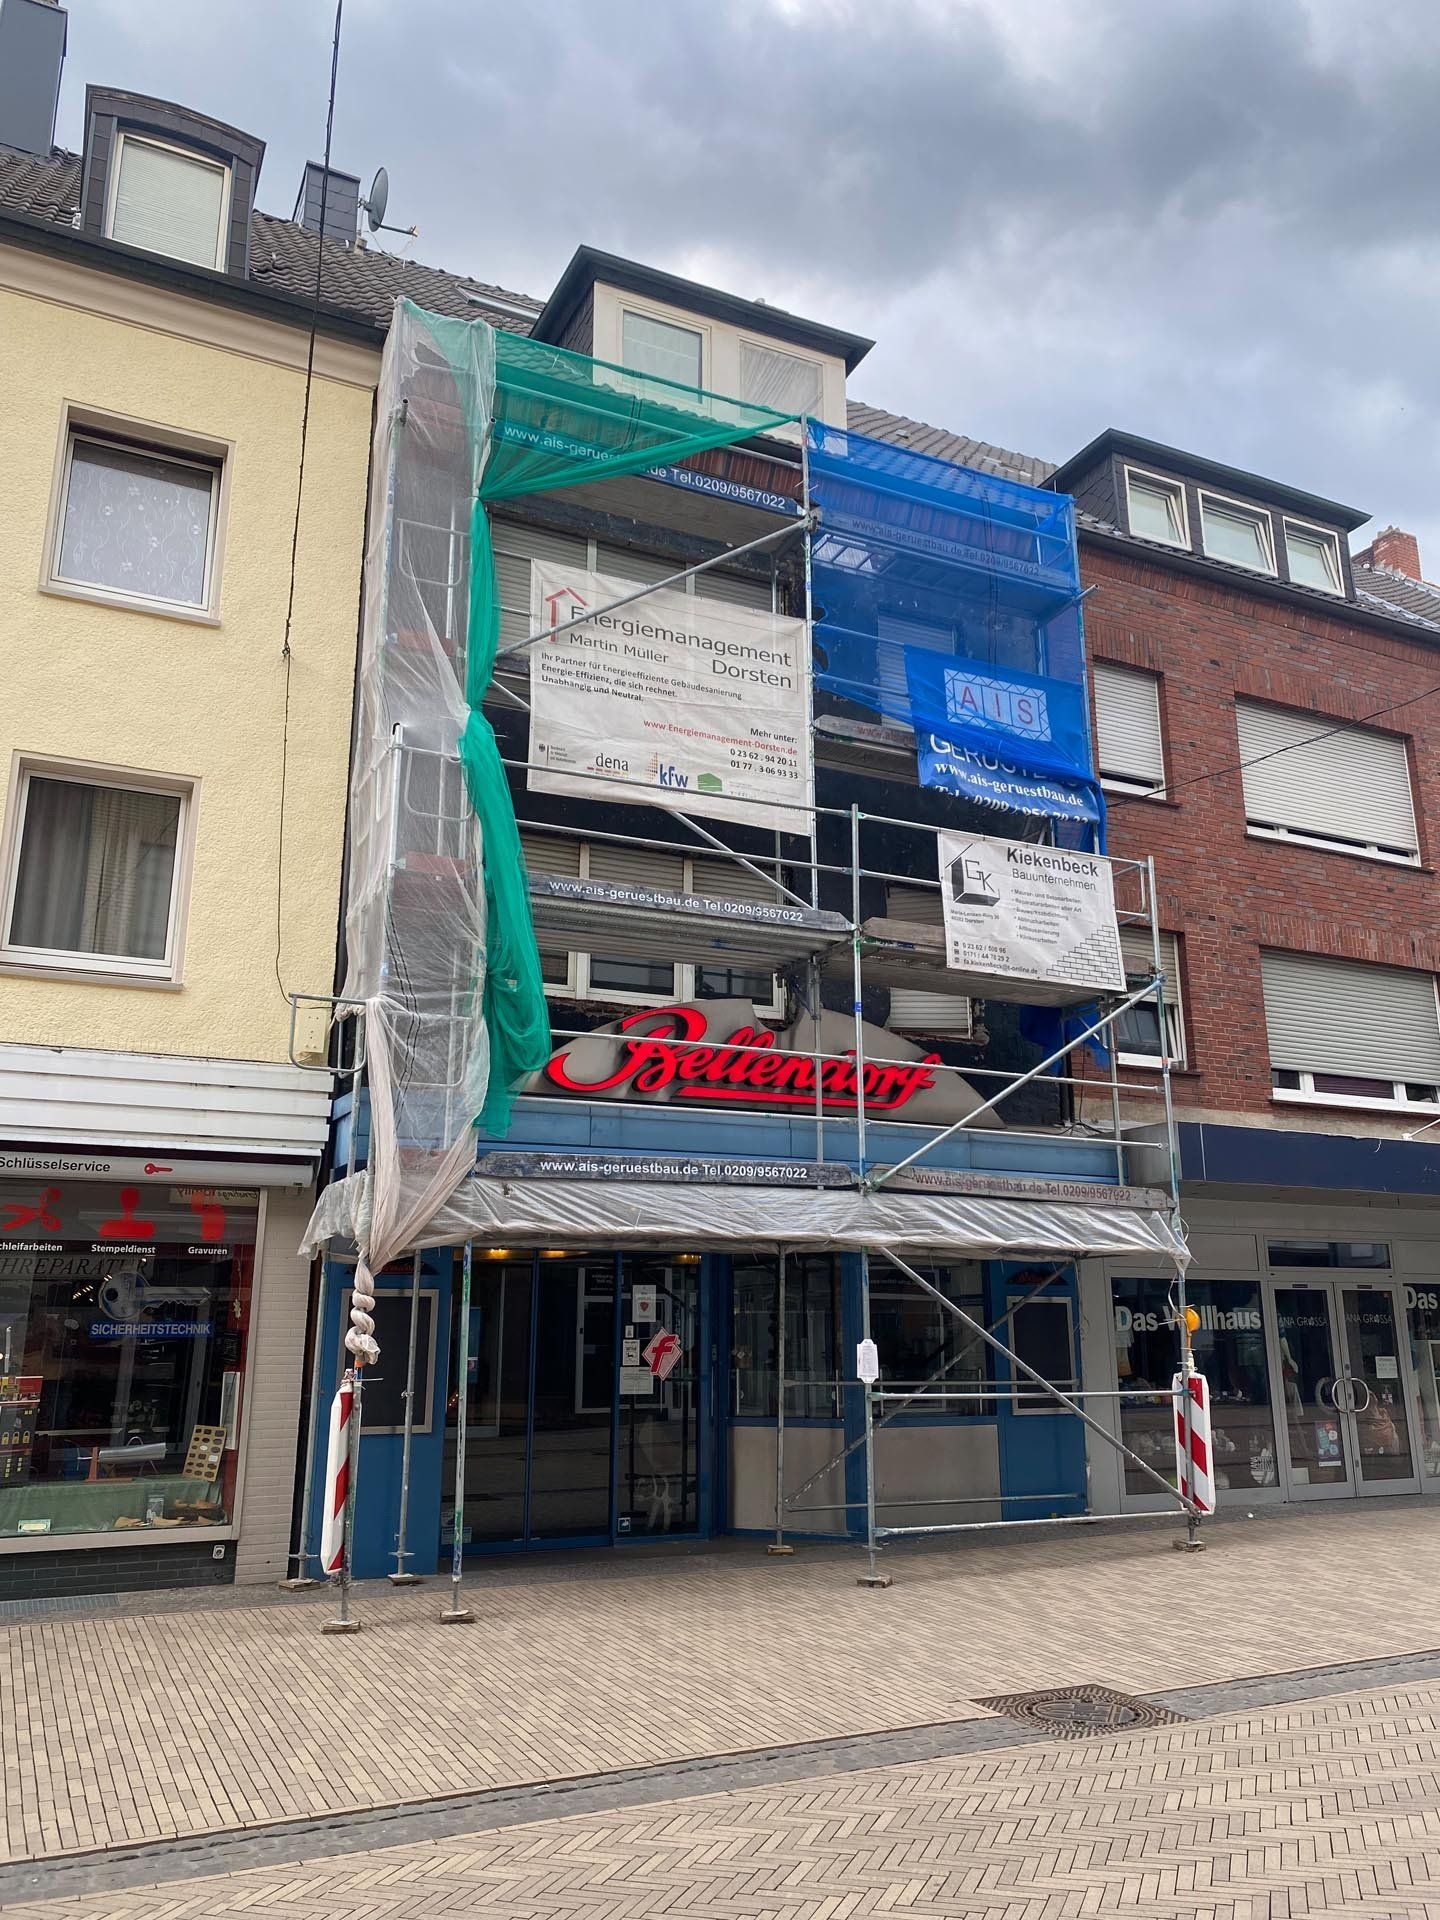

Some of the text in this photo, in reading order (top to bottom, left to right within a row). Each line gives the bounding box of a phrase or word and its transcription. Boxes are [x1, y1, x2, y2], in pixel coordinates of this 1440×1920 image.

[671, 469, 786, 509] Tel.0209/9567022
[570, 633, 669, 664] Martin Müller
[541, 652, 742, 701] Ihr Partner für Energieeffiziente Gebäudesanierung
[541, 664, 677, 698] Energie-Effizienz, die sich rechnet.
[712, 659, 792, 689] Dorsten
[541, 675, 644, 702] Unabhängig und Neutral.
[960, 686, 1033, 725] AIS
[644, 719, 798, 756] www.Energiemanagement-Dorsten.de
[750, 727, 798, 744] Mehr unter:
[595, 752, 629, 771] dena
[730, 748, 736, 756] 0
[737, 749, 747, 758] 23
[748, 751, 759, 760] 62
[764, 754, 775, 763] 94
[776, 756, 787, 766] 20
[788, 759, 797, 767] 11
[730, 760, 740, 769] 01
[742, 762, 752, 771] 77
[759, 765, 764, 773] 3
[765, 766, 776, 775] 06
[777, 769, 787, 777] 93
[788, 770, 798, 779] 33
[934, 762, 1084, 807] www.ais-geruestbau.de
[1006, 847, 1099, 877] Kiekenbeck
[1012, 868, 1096, 891] Bauunternehmen
[549, 880, 804, 922] www.ais-geruestbau.de Tel.0209/9567022
[0, 1157, 111, 1173] Schlüsselservice
[540, 1159, 808, 1179] www.ais-geruestbau.de Tel.0209/9567022
[91, 1244, 156, 1254] Stempeldienst
[188, 1246, 228, 1255] Gravuren
[1406, 1286, 1439, 1310] Das
[91, 1324, 211, 1335] SICHERHEITSTECHNIK
[1114, 1305, 1262, 1332] Das Wllhaus
